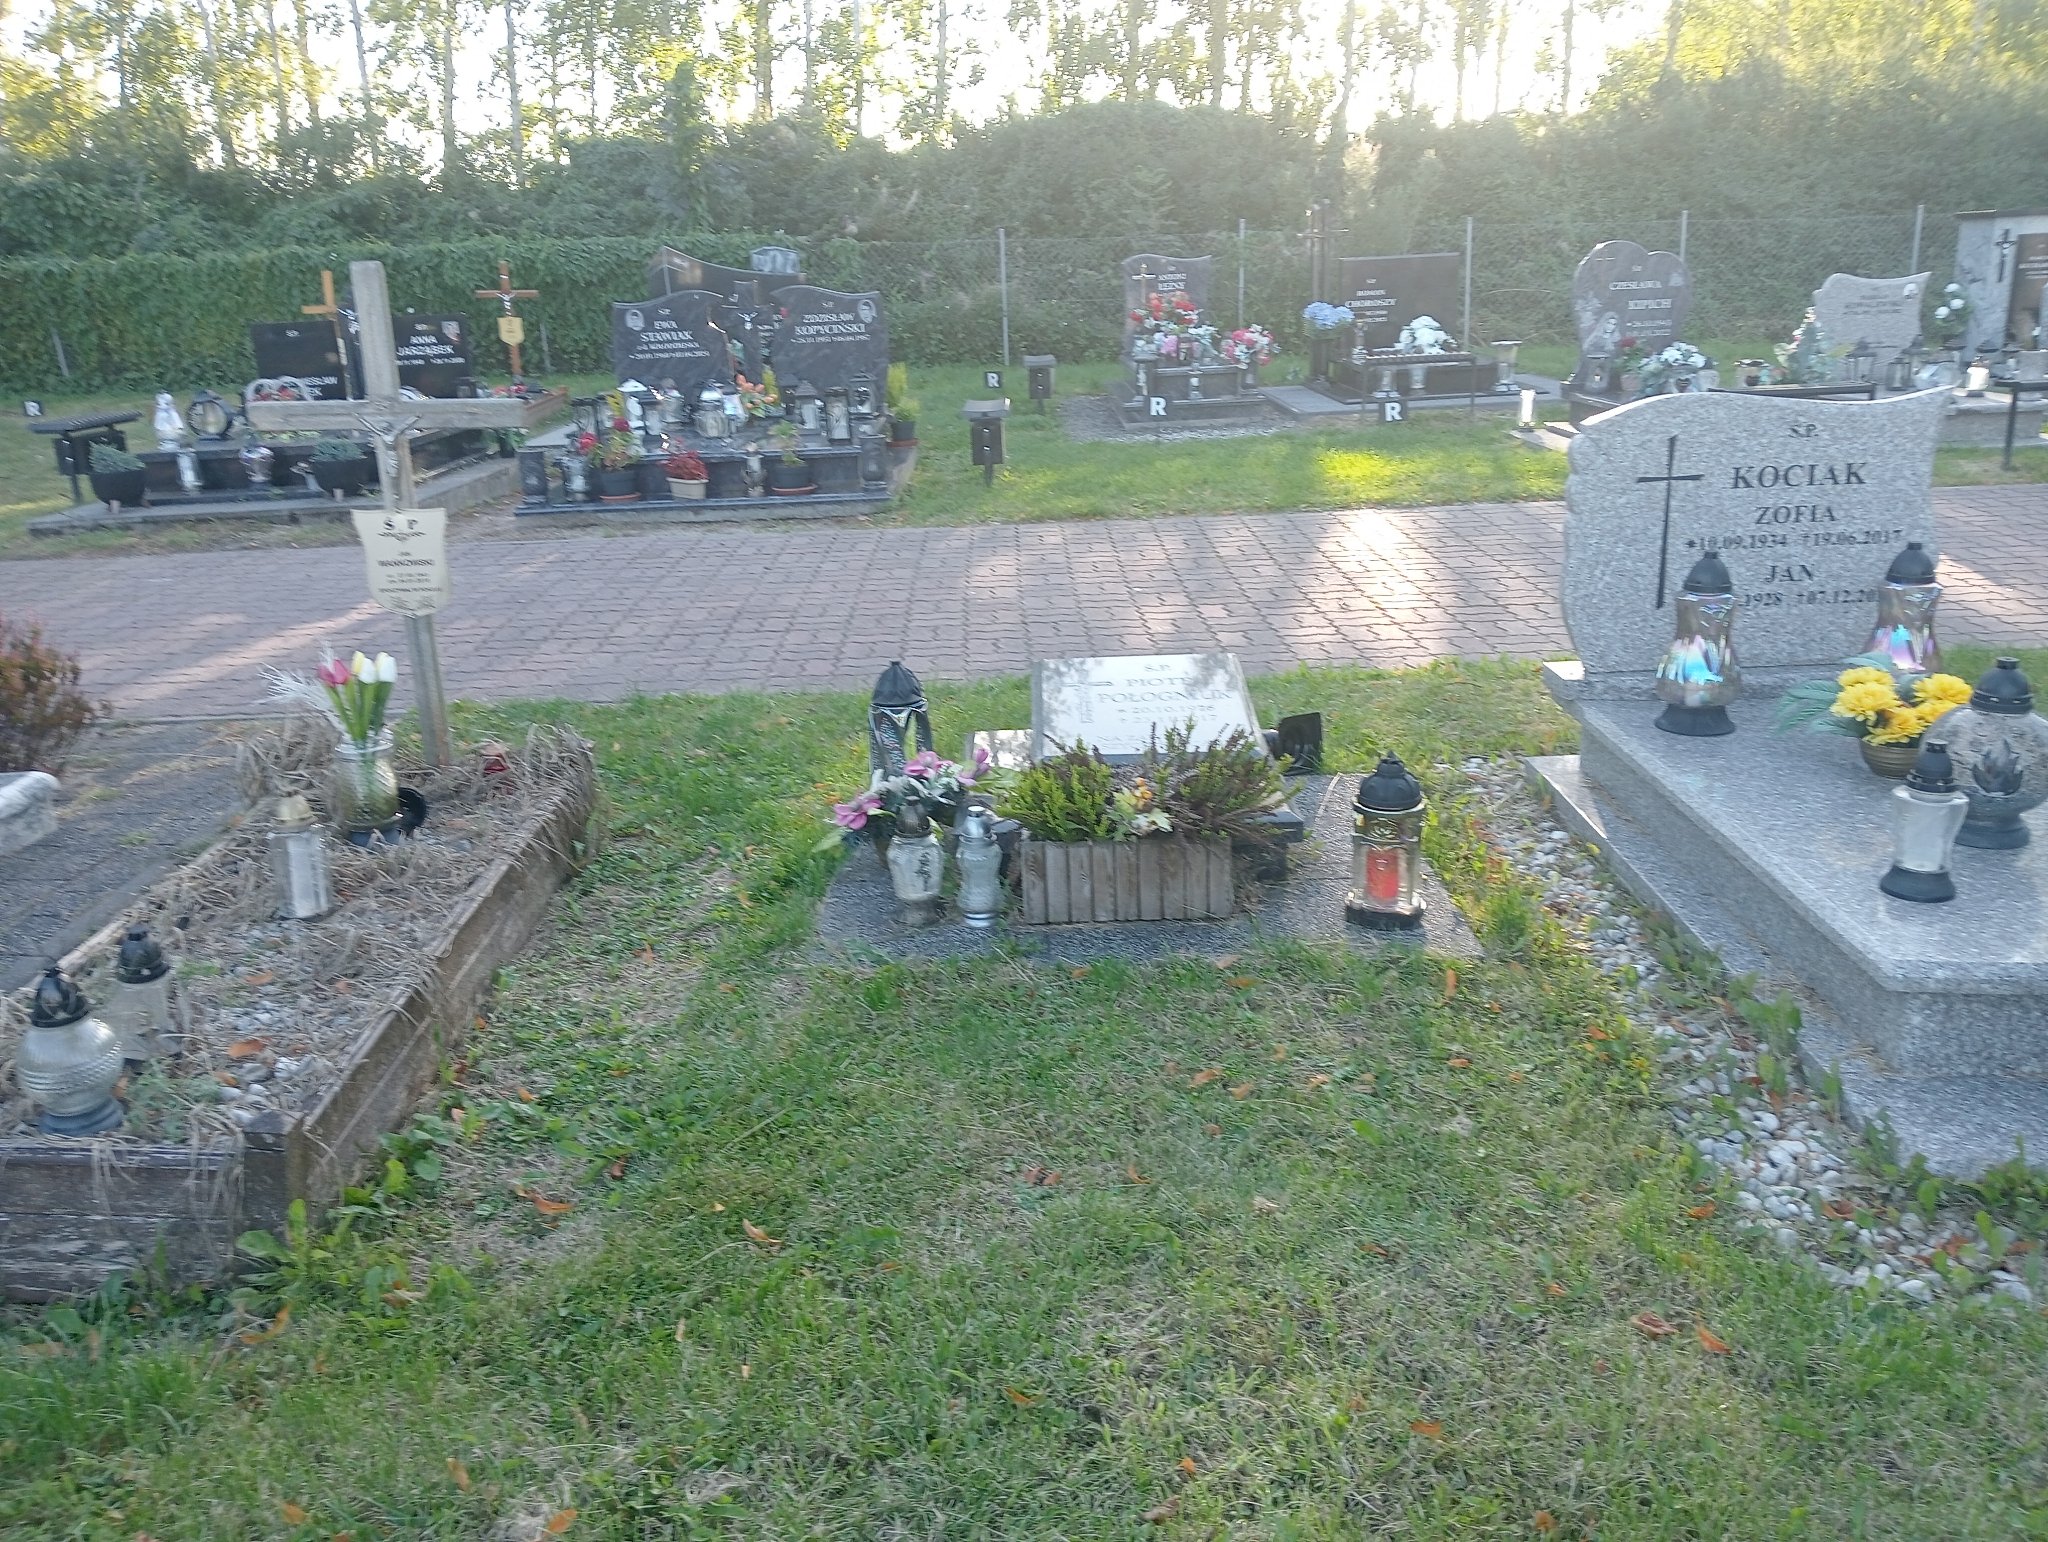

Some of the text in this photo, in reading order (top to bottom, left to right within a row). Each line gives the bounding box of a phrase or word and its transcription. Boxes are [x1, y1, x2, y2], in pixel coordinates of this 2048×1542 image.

[653, 320, 679, 330] EWA
[986, 371, 1001, 388] R
[24, 401, 42, 417] R
[1150, 396, 1167, 416] R
[1384, 402, 1403, 422] R
[1732, 463, 1867, 489] KOCIAK
[1755, 505, 1839, 525] ZOFIA
[1764, 564, 1816, 583] JAN
